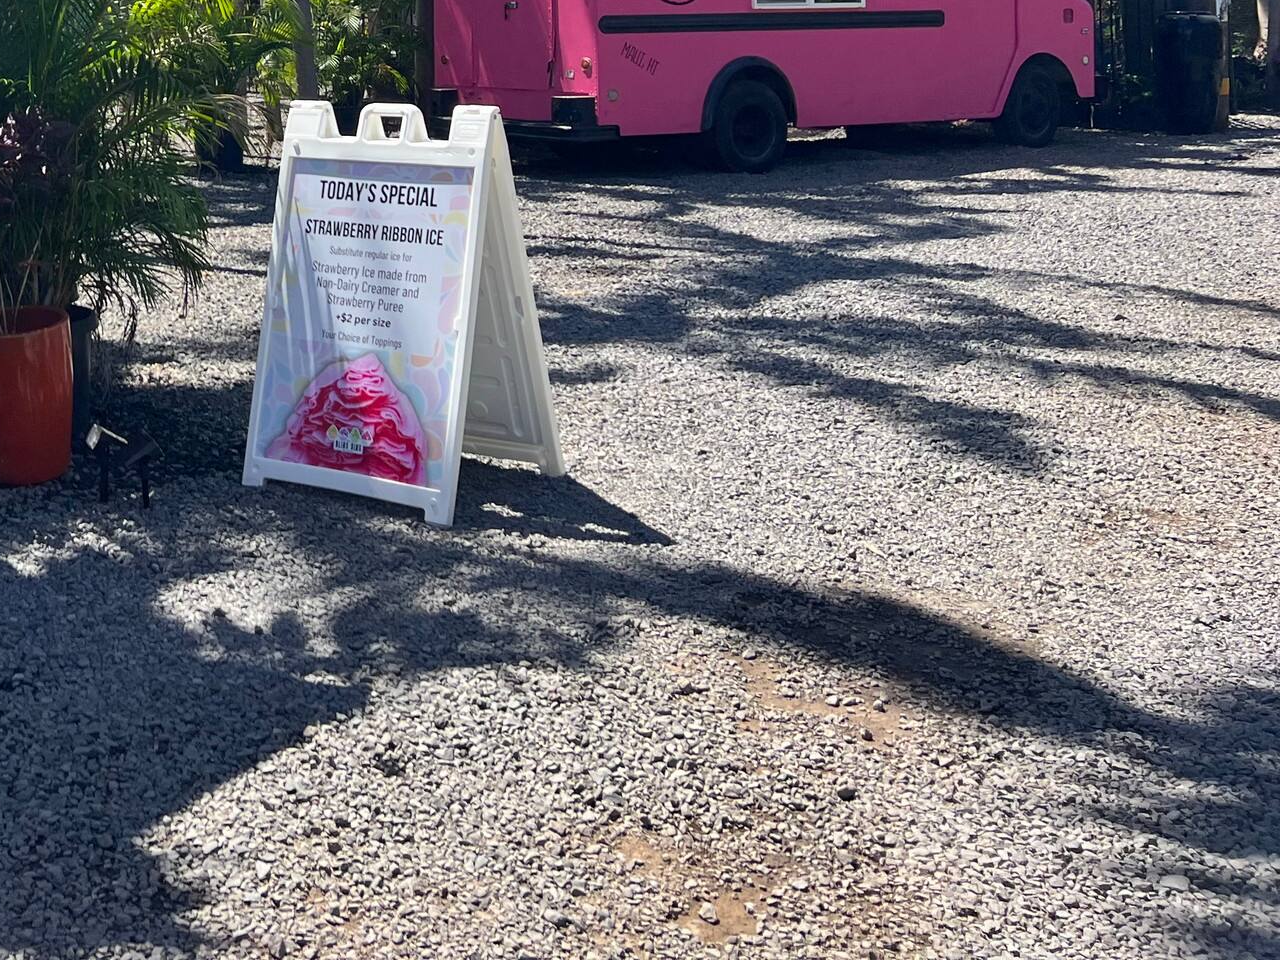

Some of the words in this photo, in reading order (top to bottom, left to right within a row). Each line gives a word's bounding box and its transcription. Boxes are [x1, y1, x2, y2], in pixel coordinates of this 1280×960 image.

[320, 180, 376, 204] TODAY'S
[379, 184, 438, 208] SPECIAL
[305, 218, 380, 240] STRAWBERRY
[380, 225, 423, 244] RIBBON
[425, 229, 445, 246] ICE
[329, 246, 363, 258] Substitute
[364, 249, 389, 261] regular
[390, 251, 401, 261] ice
[402, 252, 413, 262] for
[312, 260, 360, 279] Strawberry
[361, 265, 375, 279] Ice
[377, 267, 403, 281] made
[404, 270, 427, 284] from
[316, 276, 359, 294] Non-Dairy
[361, 280, 400, 297] Creamer
[402, 286, 420, 299] and
[327, 292, 376, 312] Strawberry
[377, 298, 404, 313] Puree
[354, 316, 371, 327] per
[372, 316, 392, 328] size
[320, 328, 336, 340] Your
[337, 330, 360, 344] Choice
[361, 334, 370, 344] of
[370, 335, 402, 350] Toppings
